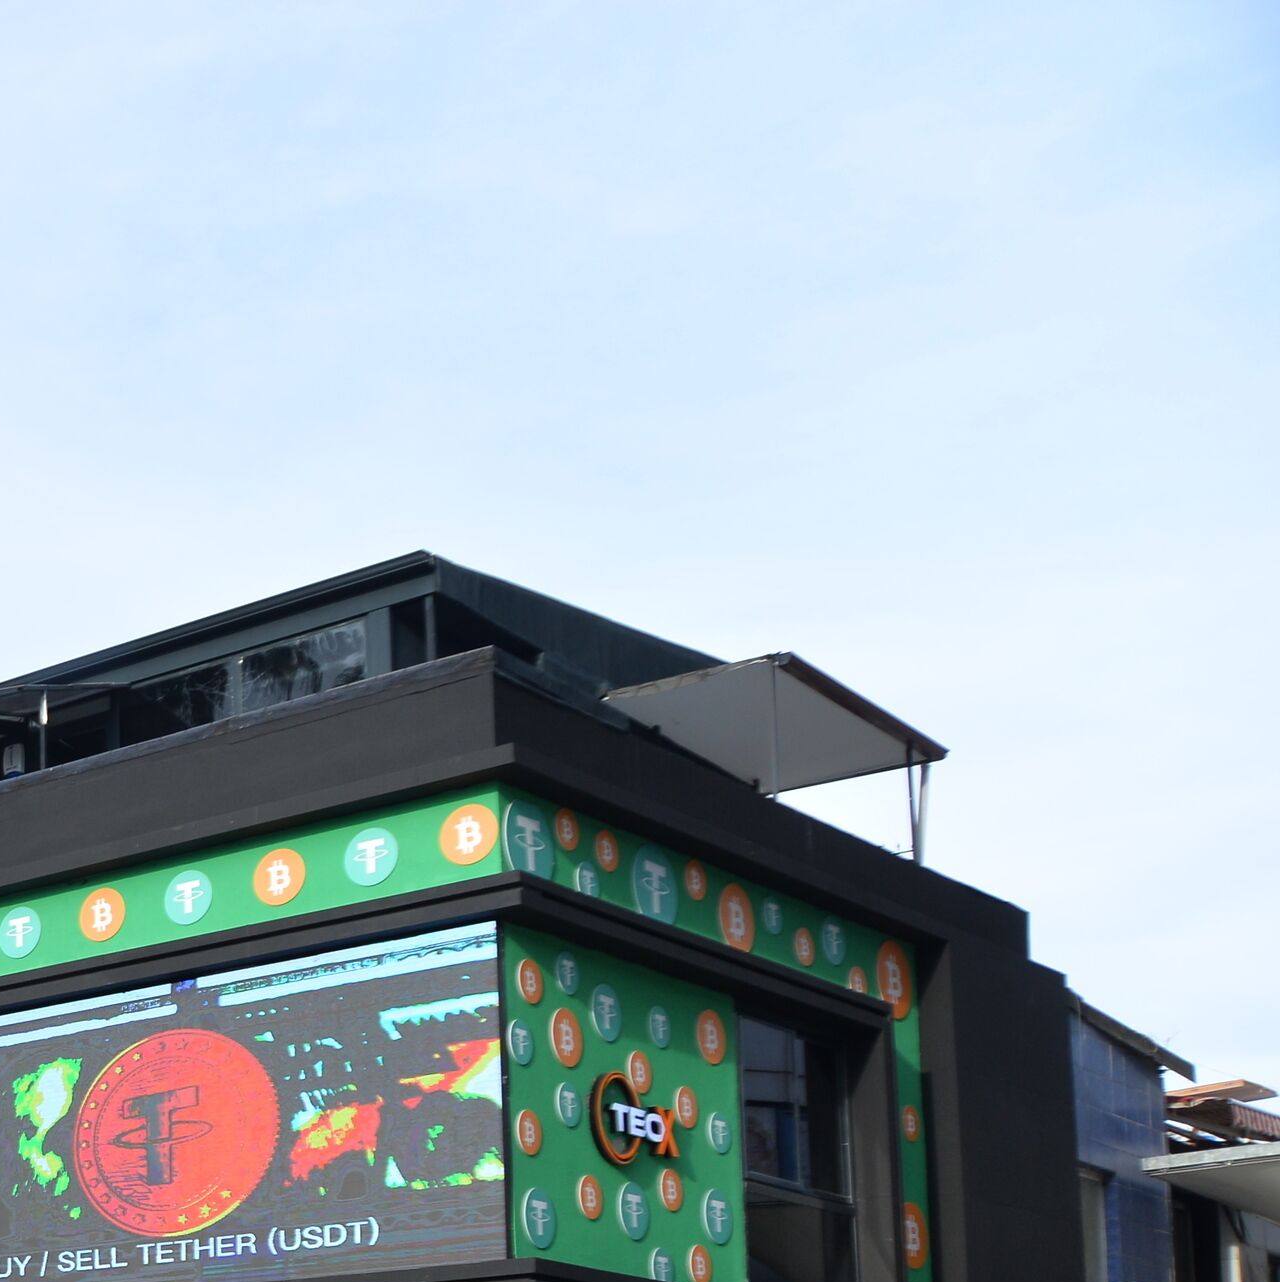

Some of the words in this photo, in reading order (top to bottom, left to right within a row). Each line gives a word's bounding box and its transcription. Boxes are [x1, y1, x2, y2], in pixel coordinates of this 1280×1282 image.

[57, 1245, 128, 1273] SELL
[137, 1232, 257, 1266] TETHER
[267, 1216, 380, 1255] (USDT)
